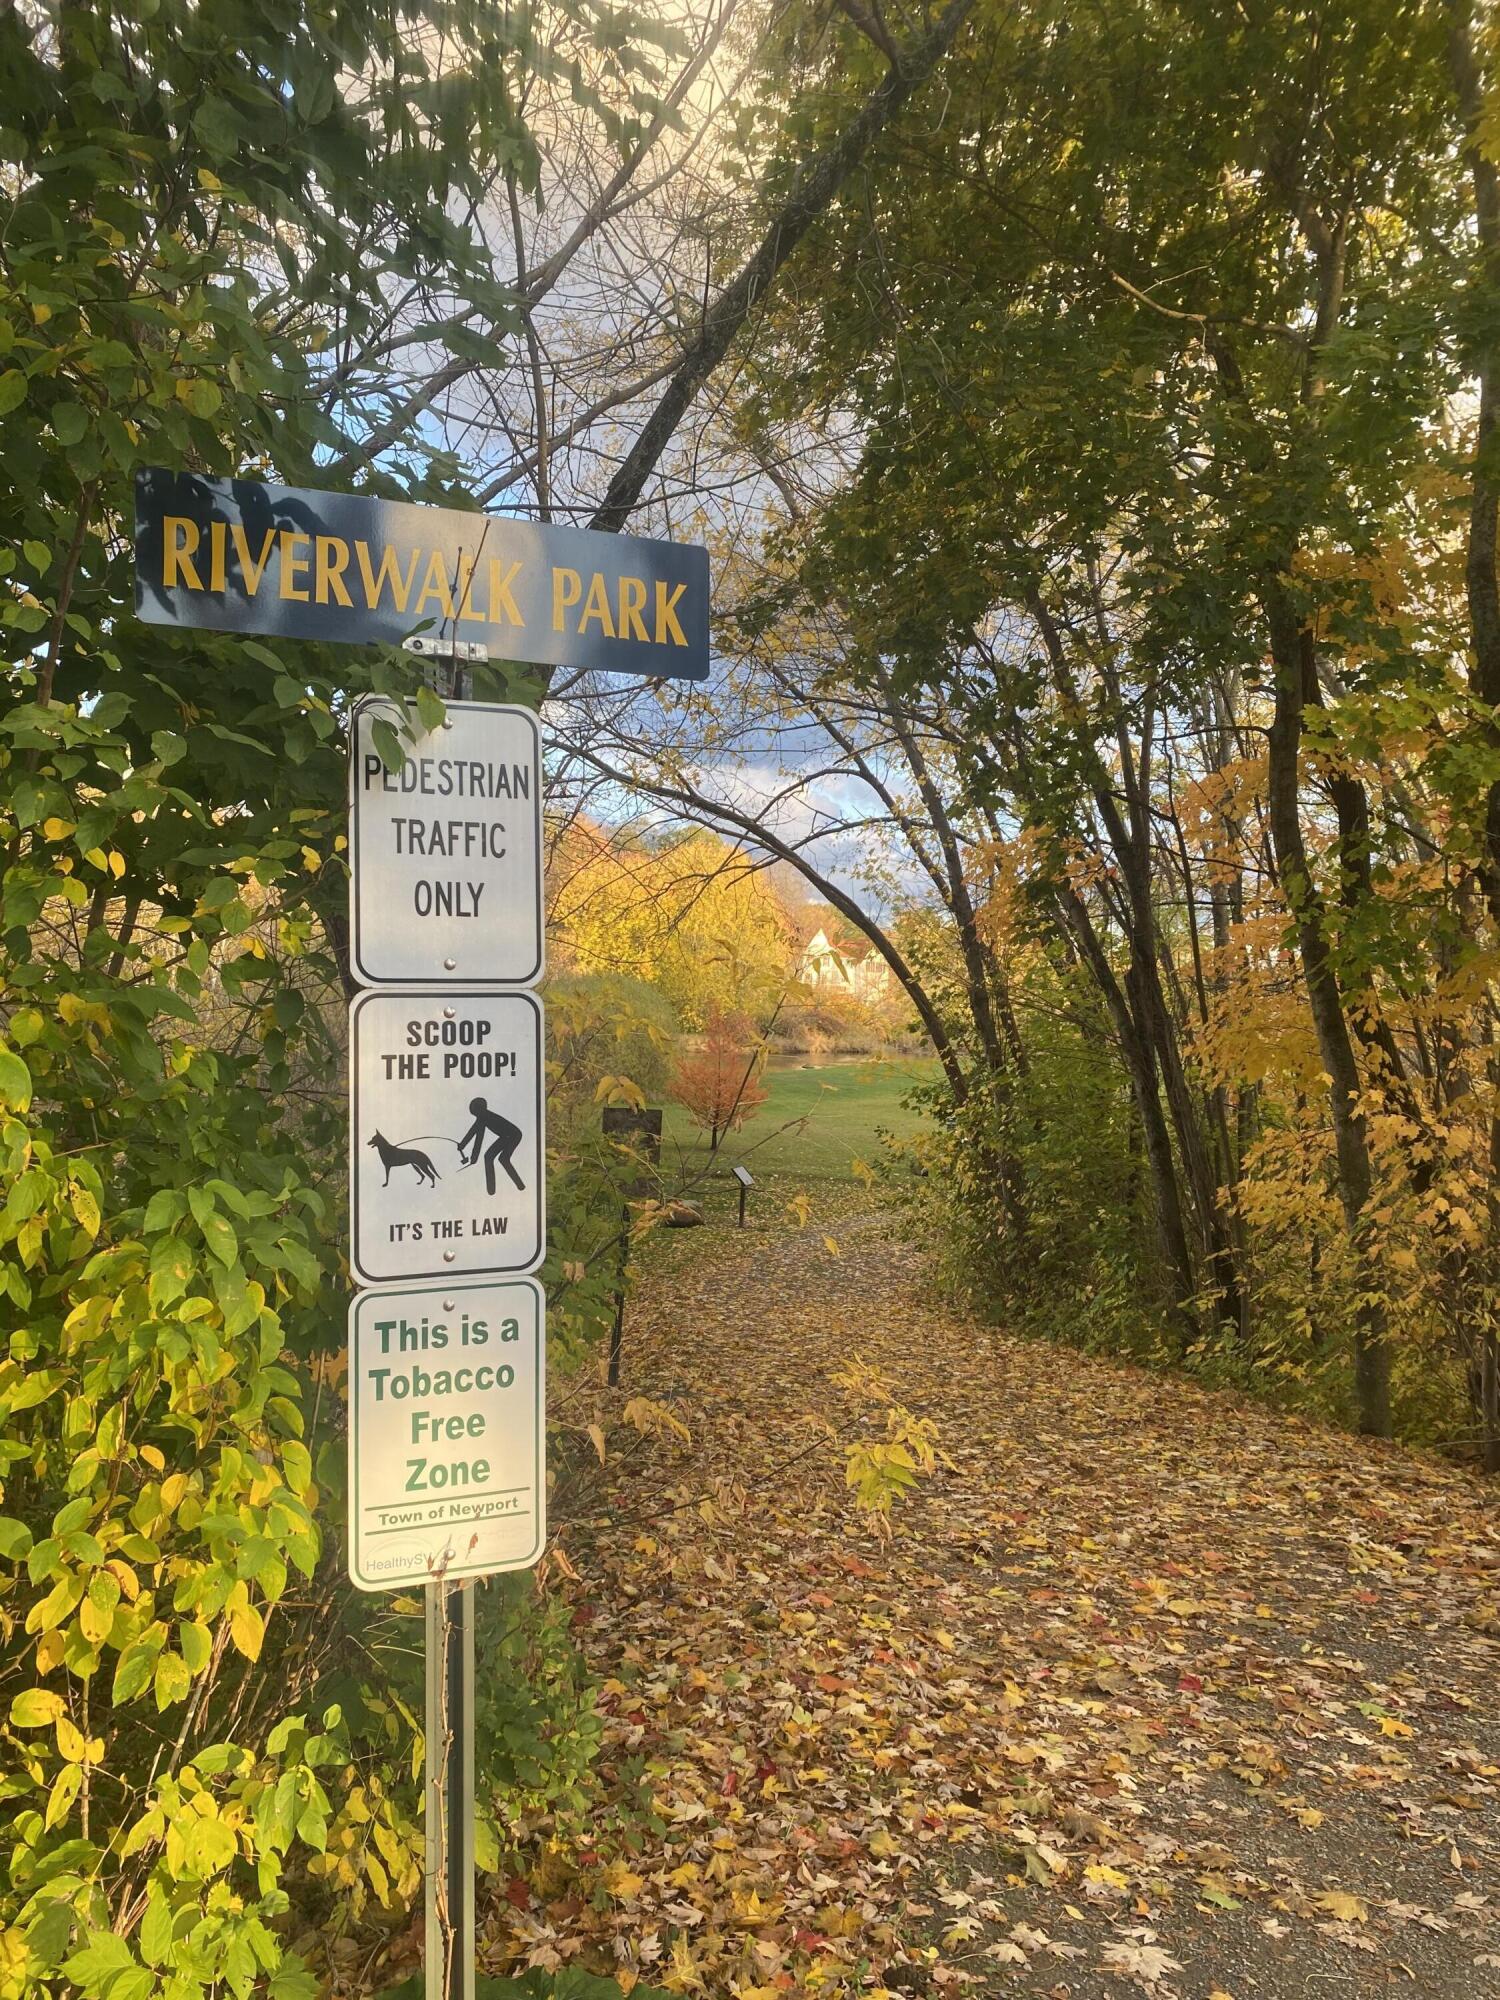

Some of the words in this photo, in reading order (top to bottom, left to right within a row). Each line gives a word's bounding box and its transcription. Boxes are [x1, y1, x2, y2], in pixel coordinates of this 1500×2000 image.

[163, 515, 526, 627] RIVERWALK
[551, 567, 689, 647] PARK
[364, 754, 529, 800] PEDESTRIAN
[391, 818, 506, 859] TRAFFIC
[414, 880, 485, 917] ONLY
[407, 1020, 491, 1047] SCOOP
[381, 1054, 430, 1080] THE
[444, 1052, 516, 1078] POOP!
[389, 1223, 423, 1242] IT'S
[431, 1220, 463, 1239] THE
[472, 1217, 508, 1236] LAW
[374, 1318, 448, 1354] This
[461, 1314, 489, 1346] is
[501, 1317, 520, 1342] a
[368, 1364, 515, 1401] Tobacco
[411, 1411, 486, 1444] Free
[405, 1458, 491, 1492] Zone
[378, 1511, 423, 1526] Town
[428, 1506, 444, 1519] of
[450, 1496, 519, 1516] Newport
